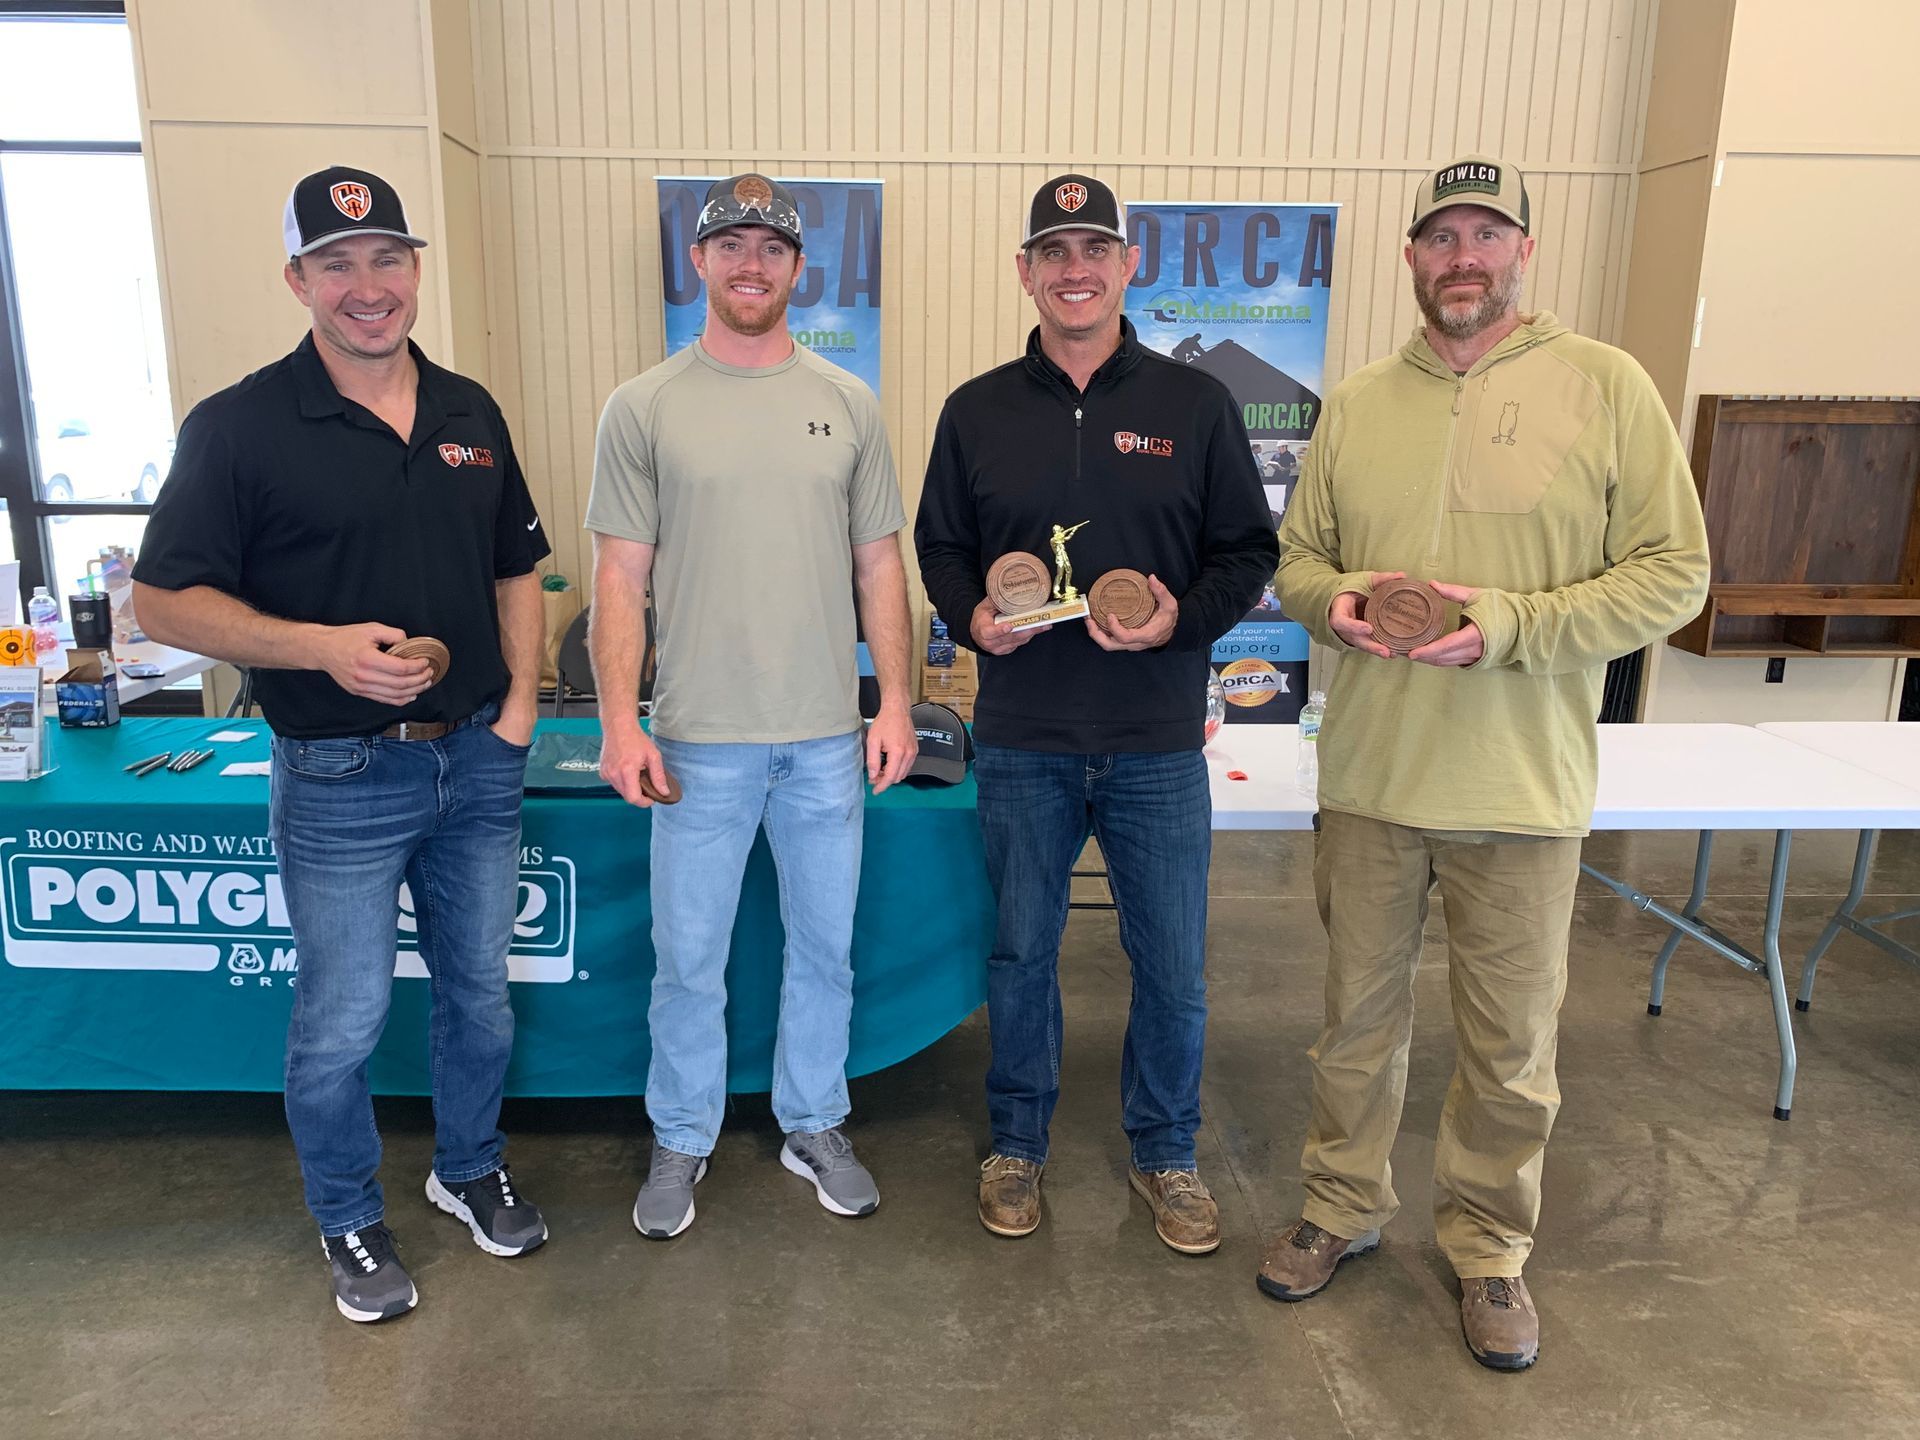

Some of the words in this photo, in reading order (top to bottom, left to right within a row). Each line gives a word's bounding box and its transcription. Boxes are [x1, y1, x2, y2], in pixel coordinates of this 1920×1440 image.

[1438, 165, 1496, 187] FOWLCO
[659, 186, 882, 308] OCA
[1126, 212, 1336, 288] ORCA
[1162, 300, 1312, 319] Oklahoma
[1243, 403, 1313, 430] ORCA?
[461, 446, 493, 463] HCS
[1136, 436, 1173, 453] HCS
[1222, 674, 1275, 688] ORCA
[26, 829, 144, 852] ROOFING
[152, 833, 207, 854] AND
